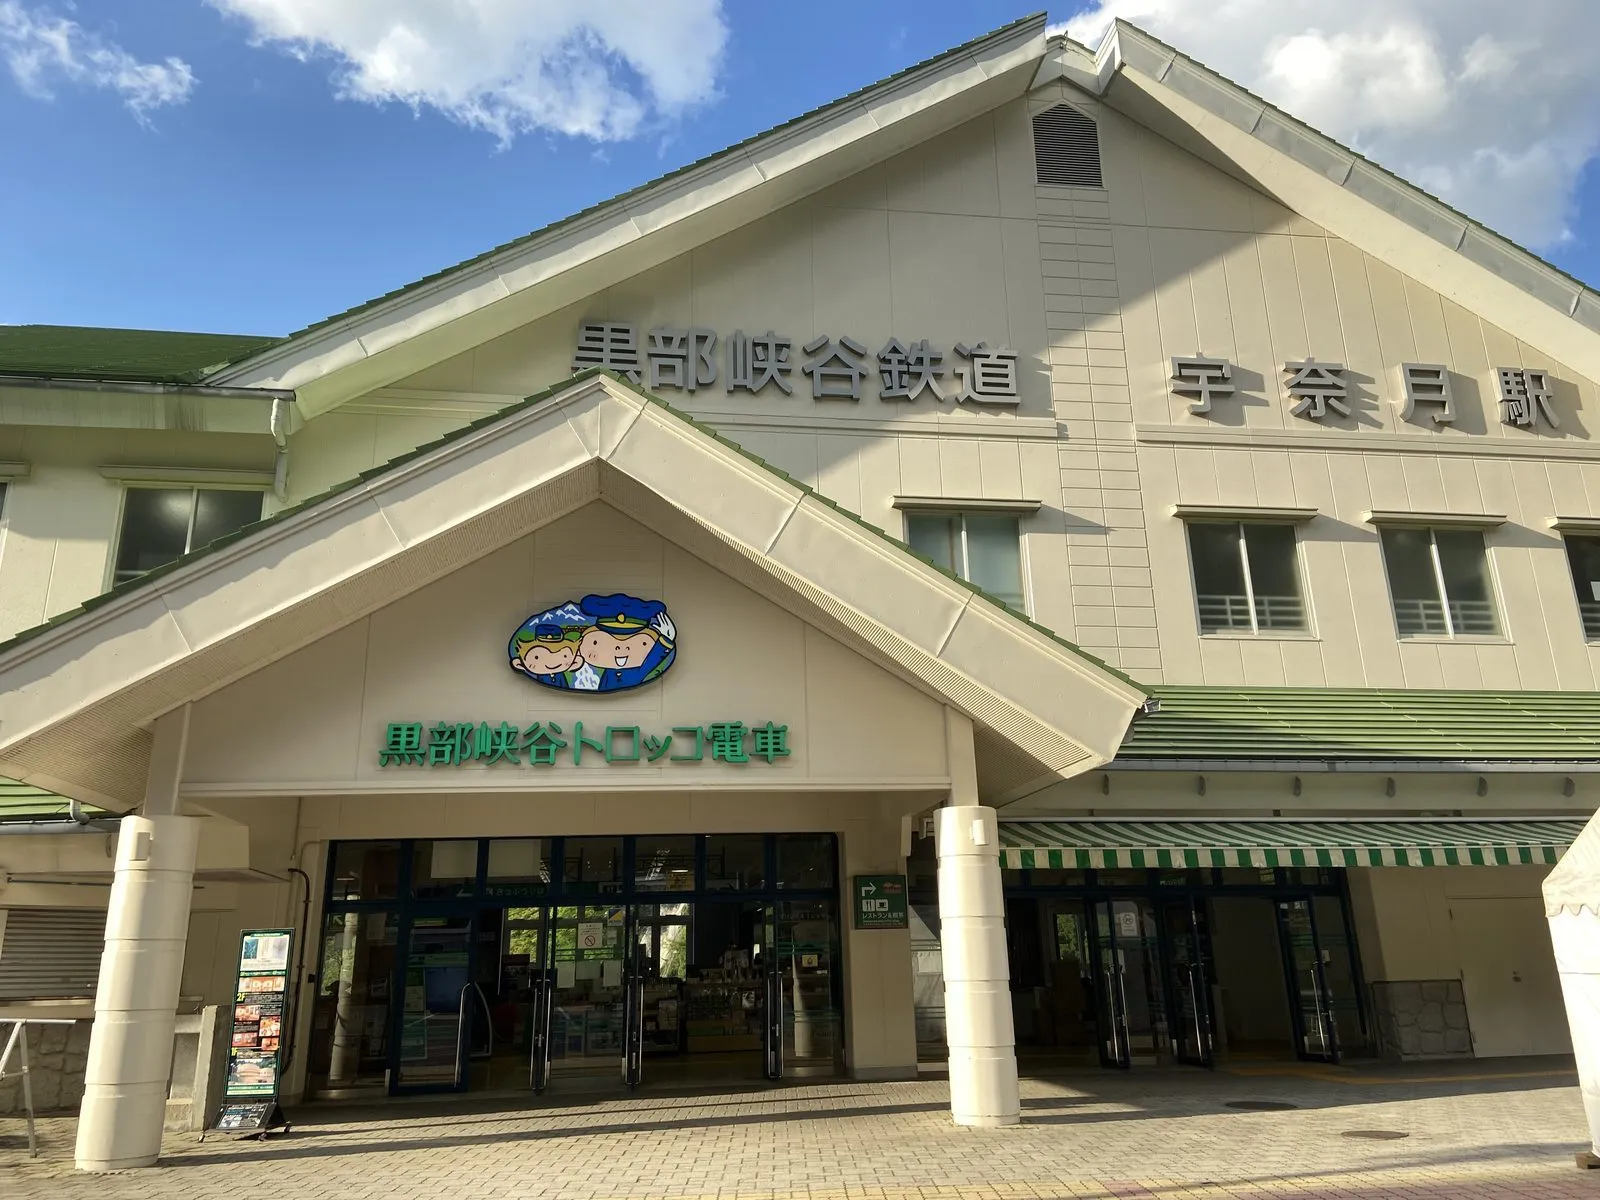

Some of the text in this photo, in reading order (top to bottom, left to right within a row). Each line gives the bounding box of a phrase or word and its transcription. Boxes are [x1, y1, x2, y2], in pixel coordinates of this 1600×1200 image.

[571, 320, 1561, 429] 黒部峡谷鉄道 宇奈月駅
[378, 720, 792, 767] 黒部峡谷トロッコ電車
[236, 993, 245, 1001] 2F
